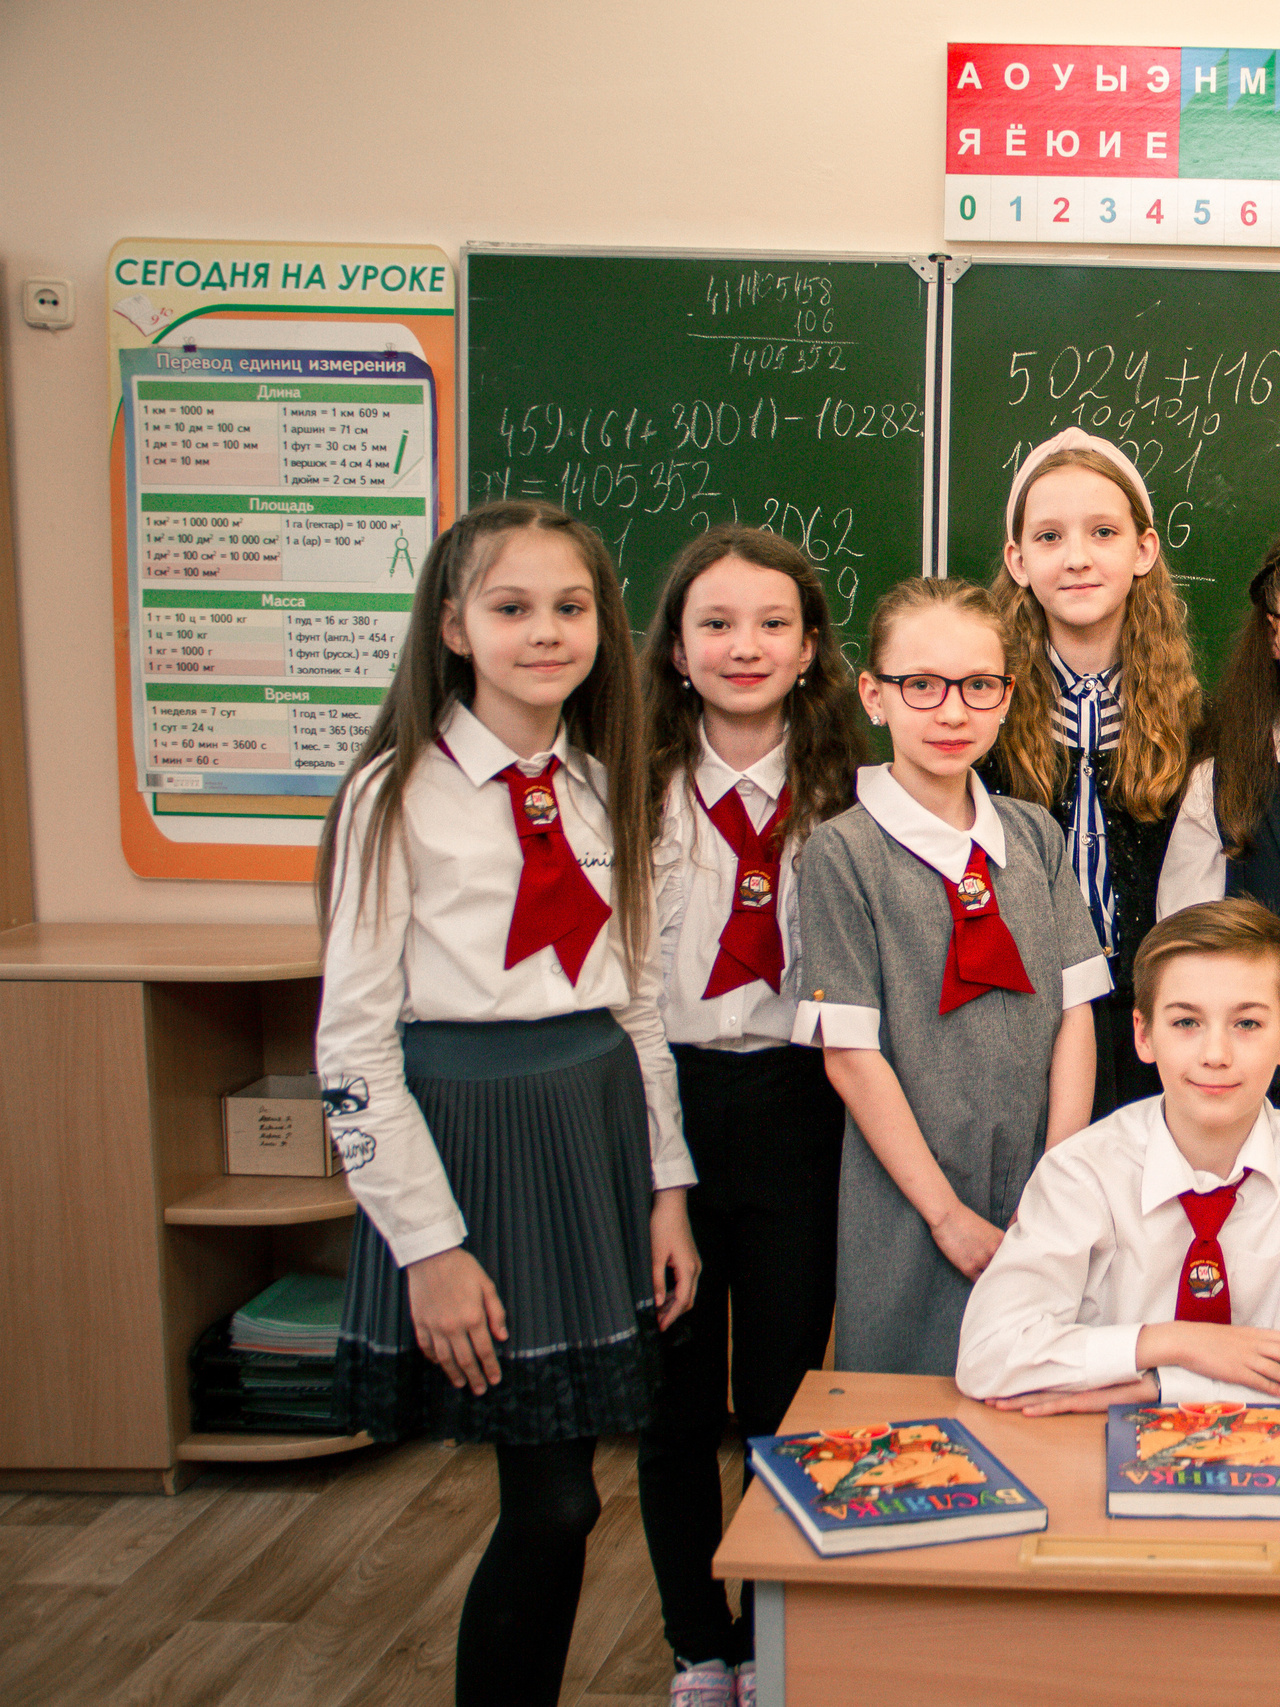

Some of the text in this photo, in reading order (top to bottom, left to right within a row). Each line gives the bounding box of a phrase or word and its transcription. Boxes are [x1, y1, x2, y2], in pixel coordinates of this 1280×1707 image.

[957, 62, 982, 89] А
[1004, 62, 1030, 90] О
[1052, 64, 1074, 91] У
[1096, 65, 1126, 91] Ы
[1147, 66, 1170, 93] Э
[1195, 67, 1216, 93] Н
[1240, 67, 1266, 94] М
[957, 128, 981, 155] Я
[1006, 123, 1026, 156] Ё
[1047, 130, 1080, 157] Ю
[1100, 131, 1121, 158] И
[1147, 132, 1167, 158] Е
[960, 195, 976, 220] 0
[1010, 196, 1022, 221] 1
[1052, 197, 1070, 223] 2
[1100, 198, 1116, 223] 3
[1146, 199, 1164, 224] 4
[1193, 200, 1211, 225] 5
[1240, 201, 1258, 226] 6
[115, 258, 446, 293] СЕГОДНЯ НА УРОКЕ
[794, 308, 834, 336] 106
[156, 353, 406, 375] Перевод единиц измерения
[257, 385, 301, 400] Длина
[180, 405, 203, 415] 1000
[359, 408, 379, 418] 609
[175, 422, 185, 432] 10
[189, 425, 203, 433] дм
[217, 423, 234, 433] 100
[291, 425, 368, 435] аршин 71 см
[291, 441, 339, 452] фут 30
[290, 460, 327, 469] вершок
[291, 475, 320, 486] дюйм
[249, 497, 314, 514] Площадь
[302, 536, 321, 547] (ар)
[261, 594, 306, 607] Масса
[210, 613, 233, 623] 1000
[295, 616, 370, 627] пуд 16 380
[296, 632, 387, 644] фунт (англ.) 454
[296, 648, 389, 660] фунт (русск.) 409
[297, 667, 341, 675] золотник
[264, 688, 310, 704] Время
[160, 708, 236, 718] неделя сут
[300, 711, 317, 719] год
[328, 709, 338, 718] 12
[191, 723, 204, 732] 24
[329, 725, 347, 735] 365
[181, 739, 195, 748] 60
[232, 740, 257, 750] 3600
[294, 758, 336, 769] февраль
